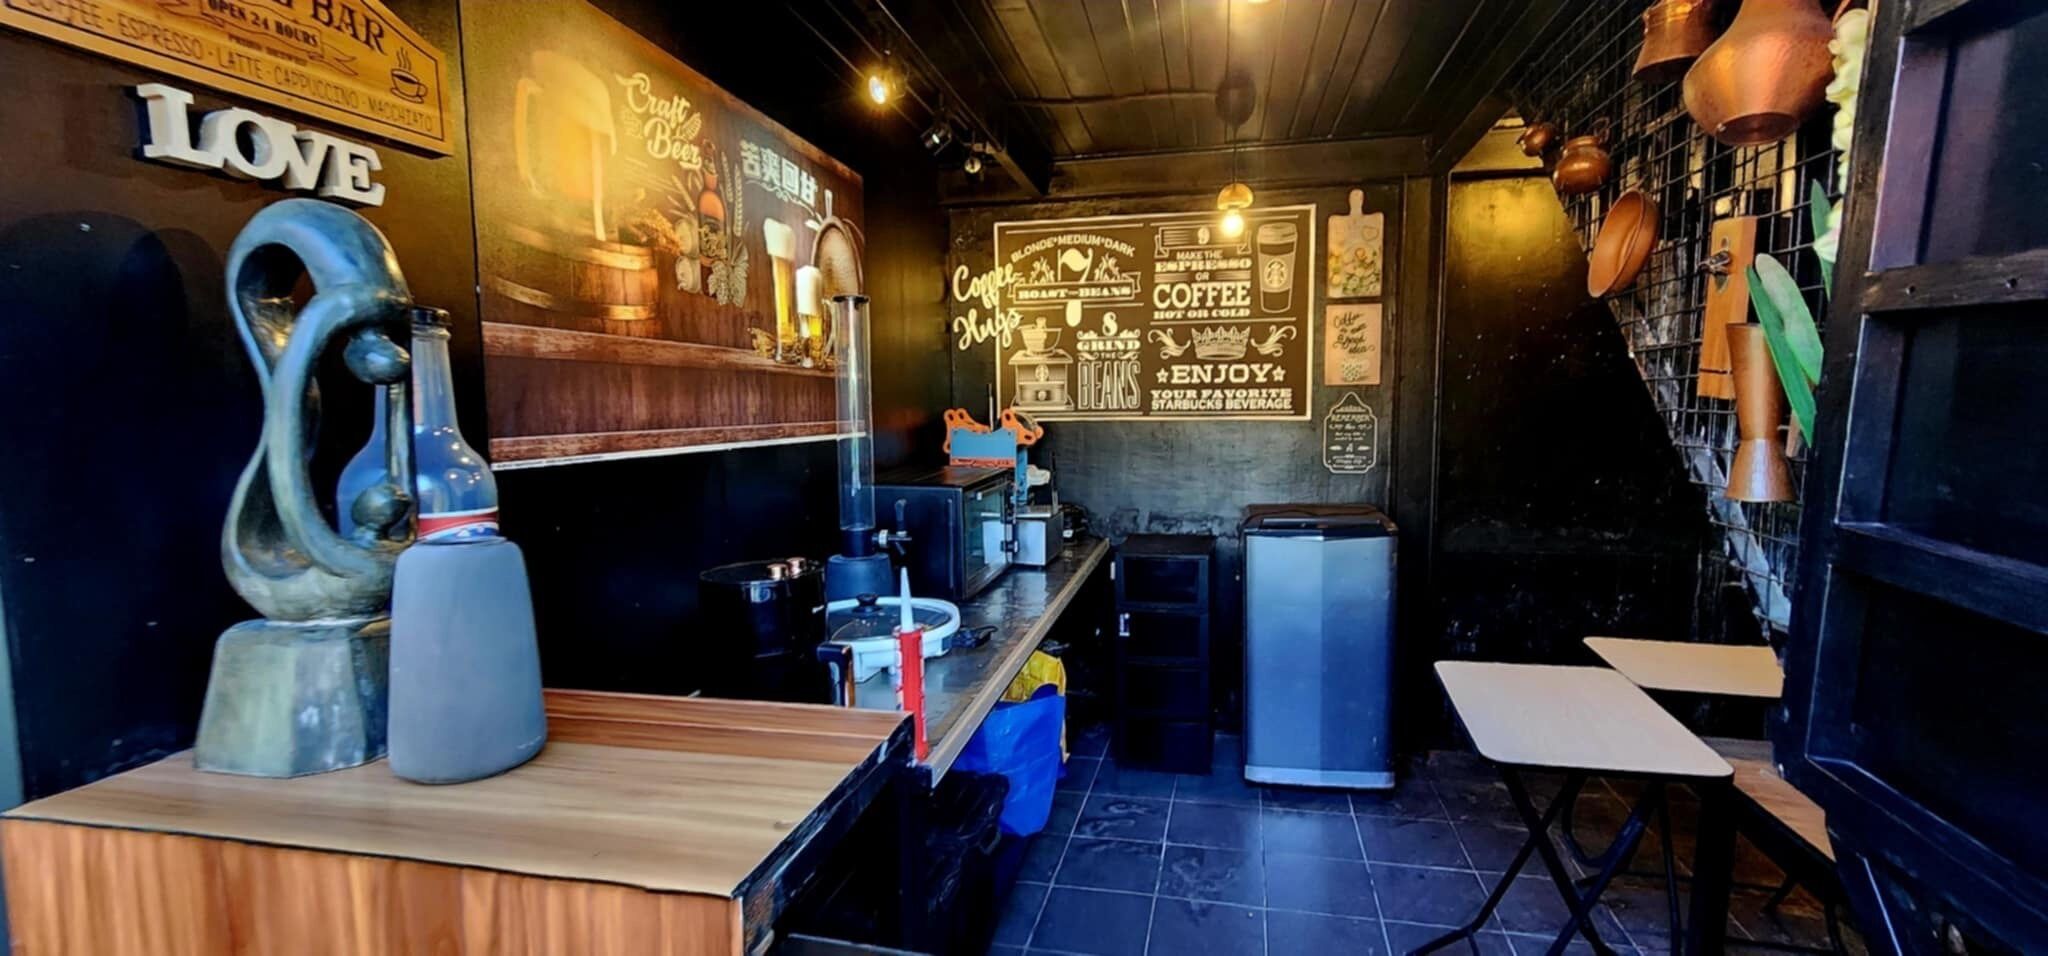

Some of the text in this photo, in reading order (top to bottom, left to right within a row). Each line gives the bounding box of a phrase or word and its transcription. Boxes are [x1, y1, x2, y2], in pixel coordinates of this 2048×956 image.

[208, 0, 247, 21] OPEN
[251, 11, 270, 31] 24
[274, 20, 319, 47] HOURS
[311, 0, 388, 56] BAR
[27, 0, 105, 29] OFFEE
[117, 12, 203, 60] ESPRESSO
[218, 46, 264, 81] LATTE
[615, 72, 691, 130] Craft
[136, 82, 386, 207] LOVE
[644, 116, 703, 170] Beer
[1196, 225, 1210, 245] 9
[1104, 237, 1136, 258] DARK
[1176, 248, 1223, 260] MAKE THE
[1154, 257, 1253, 273] ESPRESSO
[1195, 271, 1211, 281] OR
[952, 262, 1023, 310] Coffee
[1018, 288, 1069, 300] ROAST
[1078, 286, 1131, 298] BEANS
[1152, 280, 1252, 309] COFFEE
[1102, 312, 1119, 337] 8
[1153, 307, 1251, 320] HOT OR COLD
[953, 308, 1024, 351] Hugs
[1076, 339, 1141, 351] GRIND
[1077, 360, 1141, 410] BEANS
[1170, 363, 1274, 384] ENJOY
[1150, 388, 1292, 399] YOUR FAVORITE
[1151, 398, 1292, 410] STARBUCKS BEVERAGE
